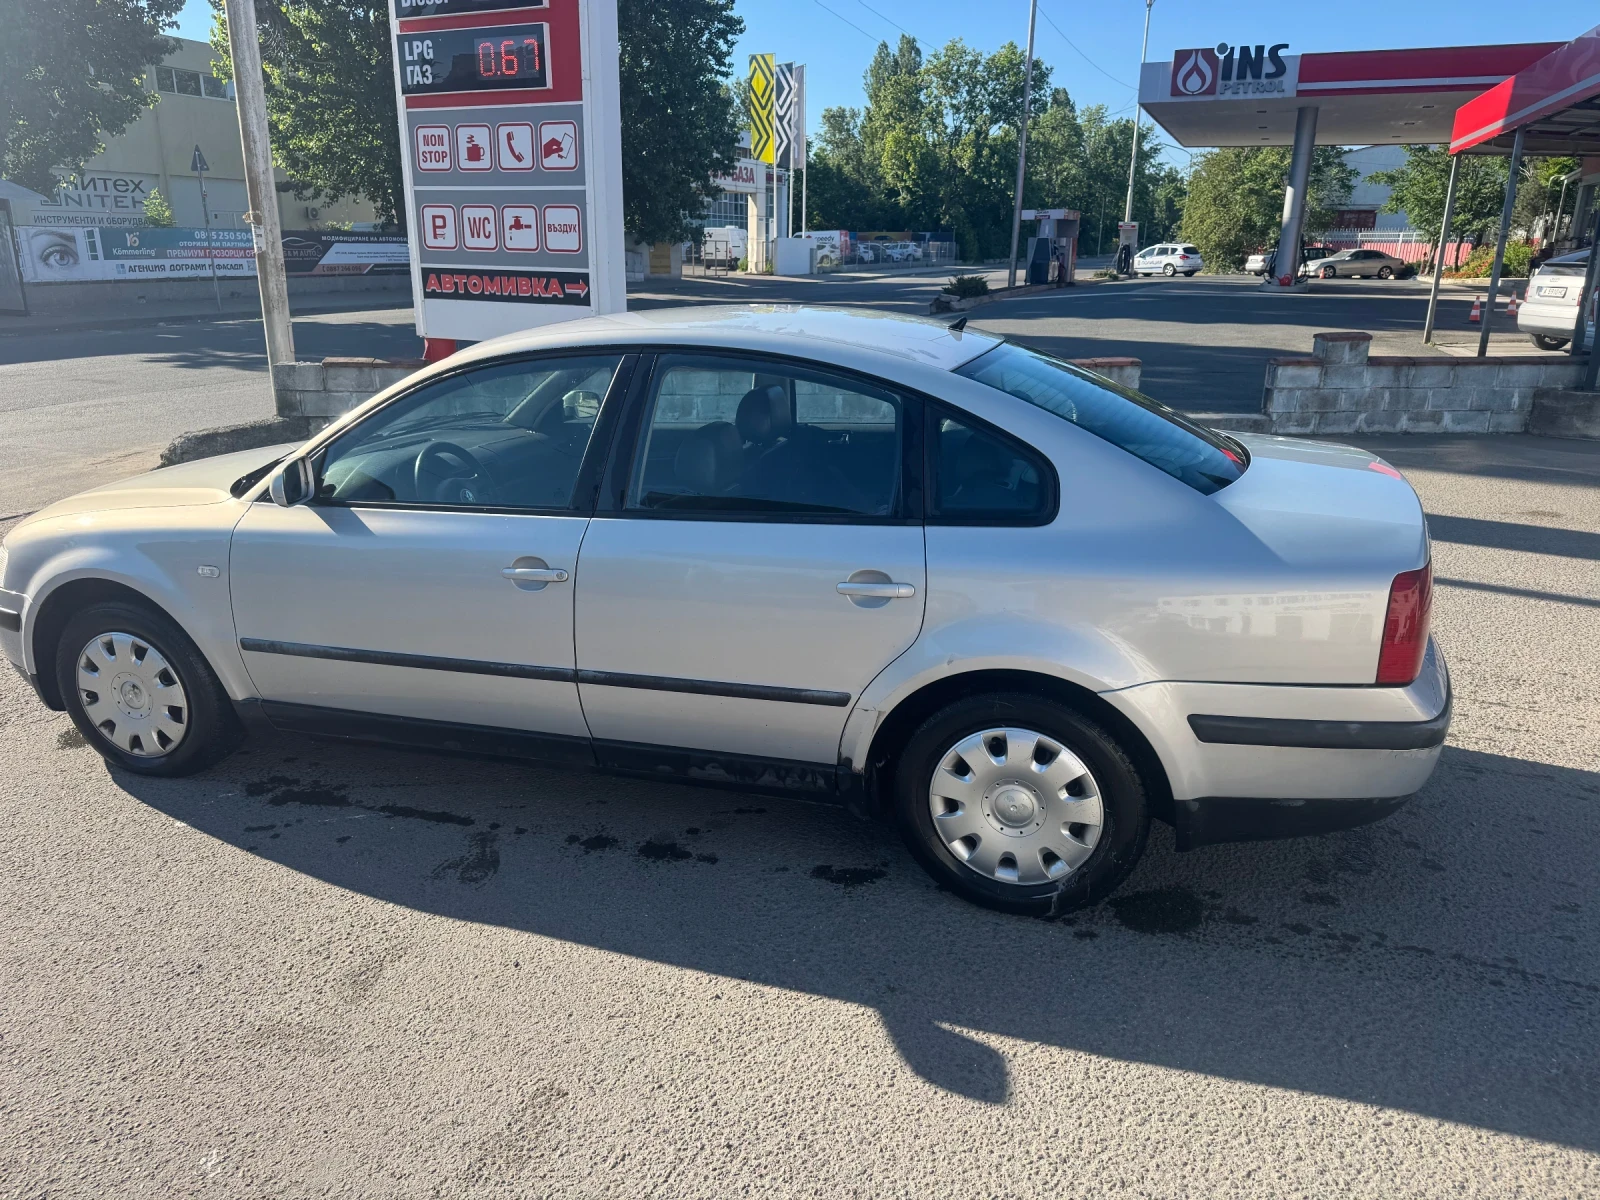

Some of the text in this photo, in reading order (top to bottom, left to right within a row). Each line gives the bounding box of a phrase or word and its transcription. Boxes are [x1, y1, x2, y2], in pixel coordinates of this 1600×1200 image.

[404, 39, 434, 61] LPG
[478, 38, 540, 77] 0.67
[406, 64, 433, 86] ГАЗ
[1219, 80, 1285, 95] PETROL
[422, 133, 445, 147] NON
[421, 150, 448, 164] STOP
[33, 214, 96, 224] ИНСТРУМЕНТИ
[467, 216, 492, 239] WC
[547, 223, 577, 235] ВЪЗДУХ
[218, 231, 235, 240] 250
[236, 231, 252, 241] 504
[166, 249, 205, 259] ПРЕМИУМ
[128, 264, 166, 273] АГЕНЦИЯ
[169, 263, 207, 272] ДОГРАМИ
[215, 262, 244, 271] ФАСАДИ
[425, 273, 564, 298] АВТОМИВКА
